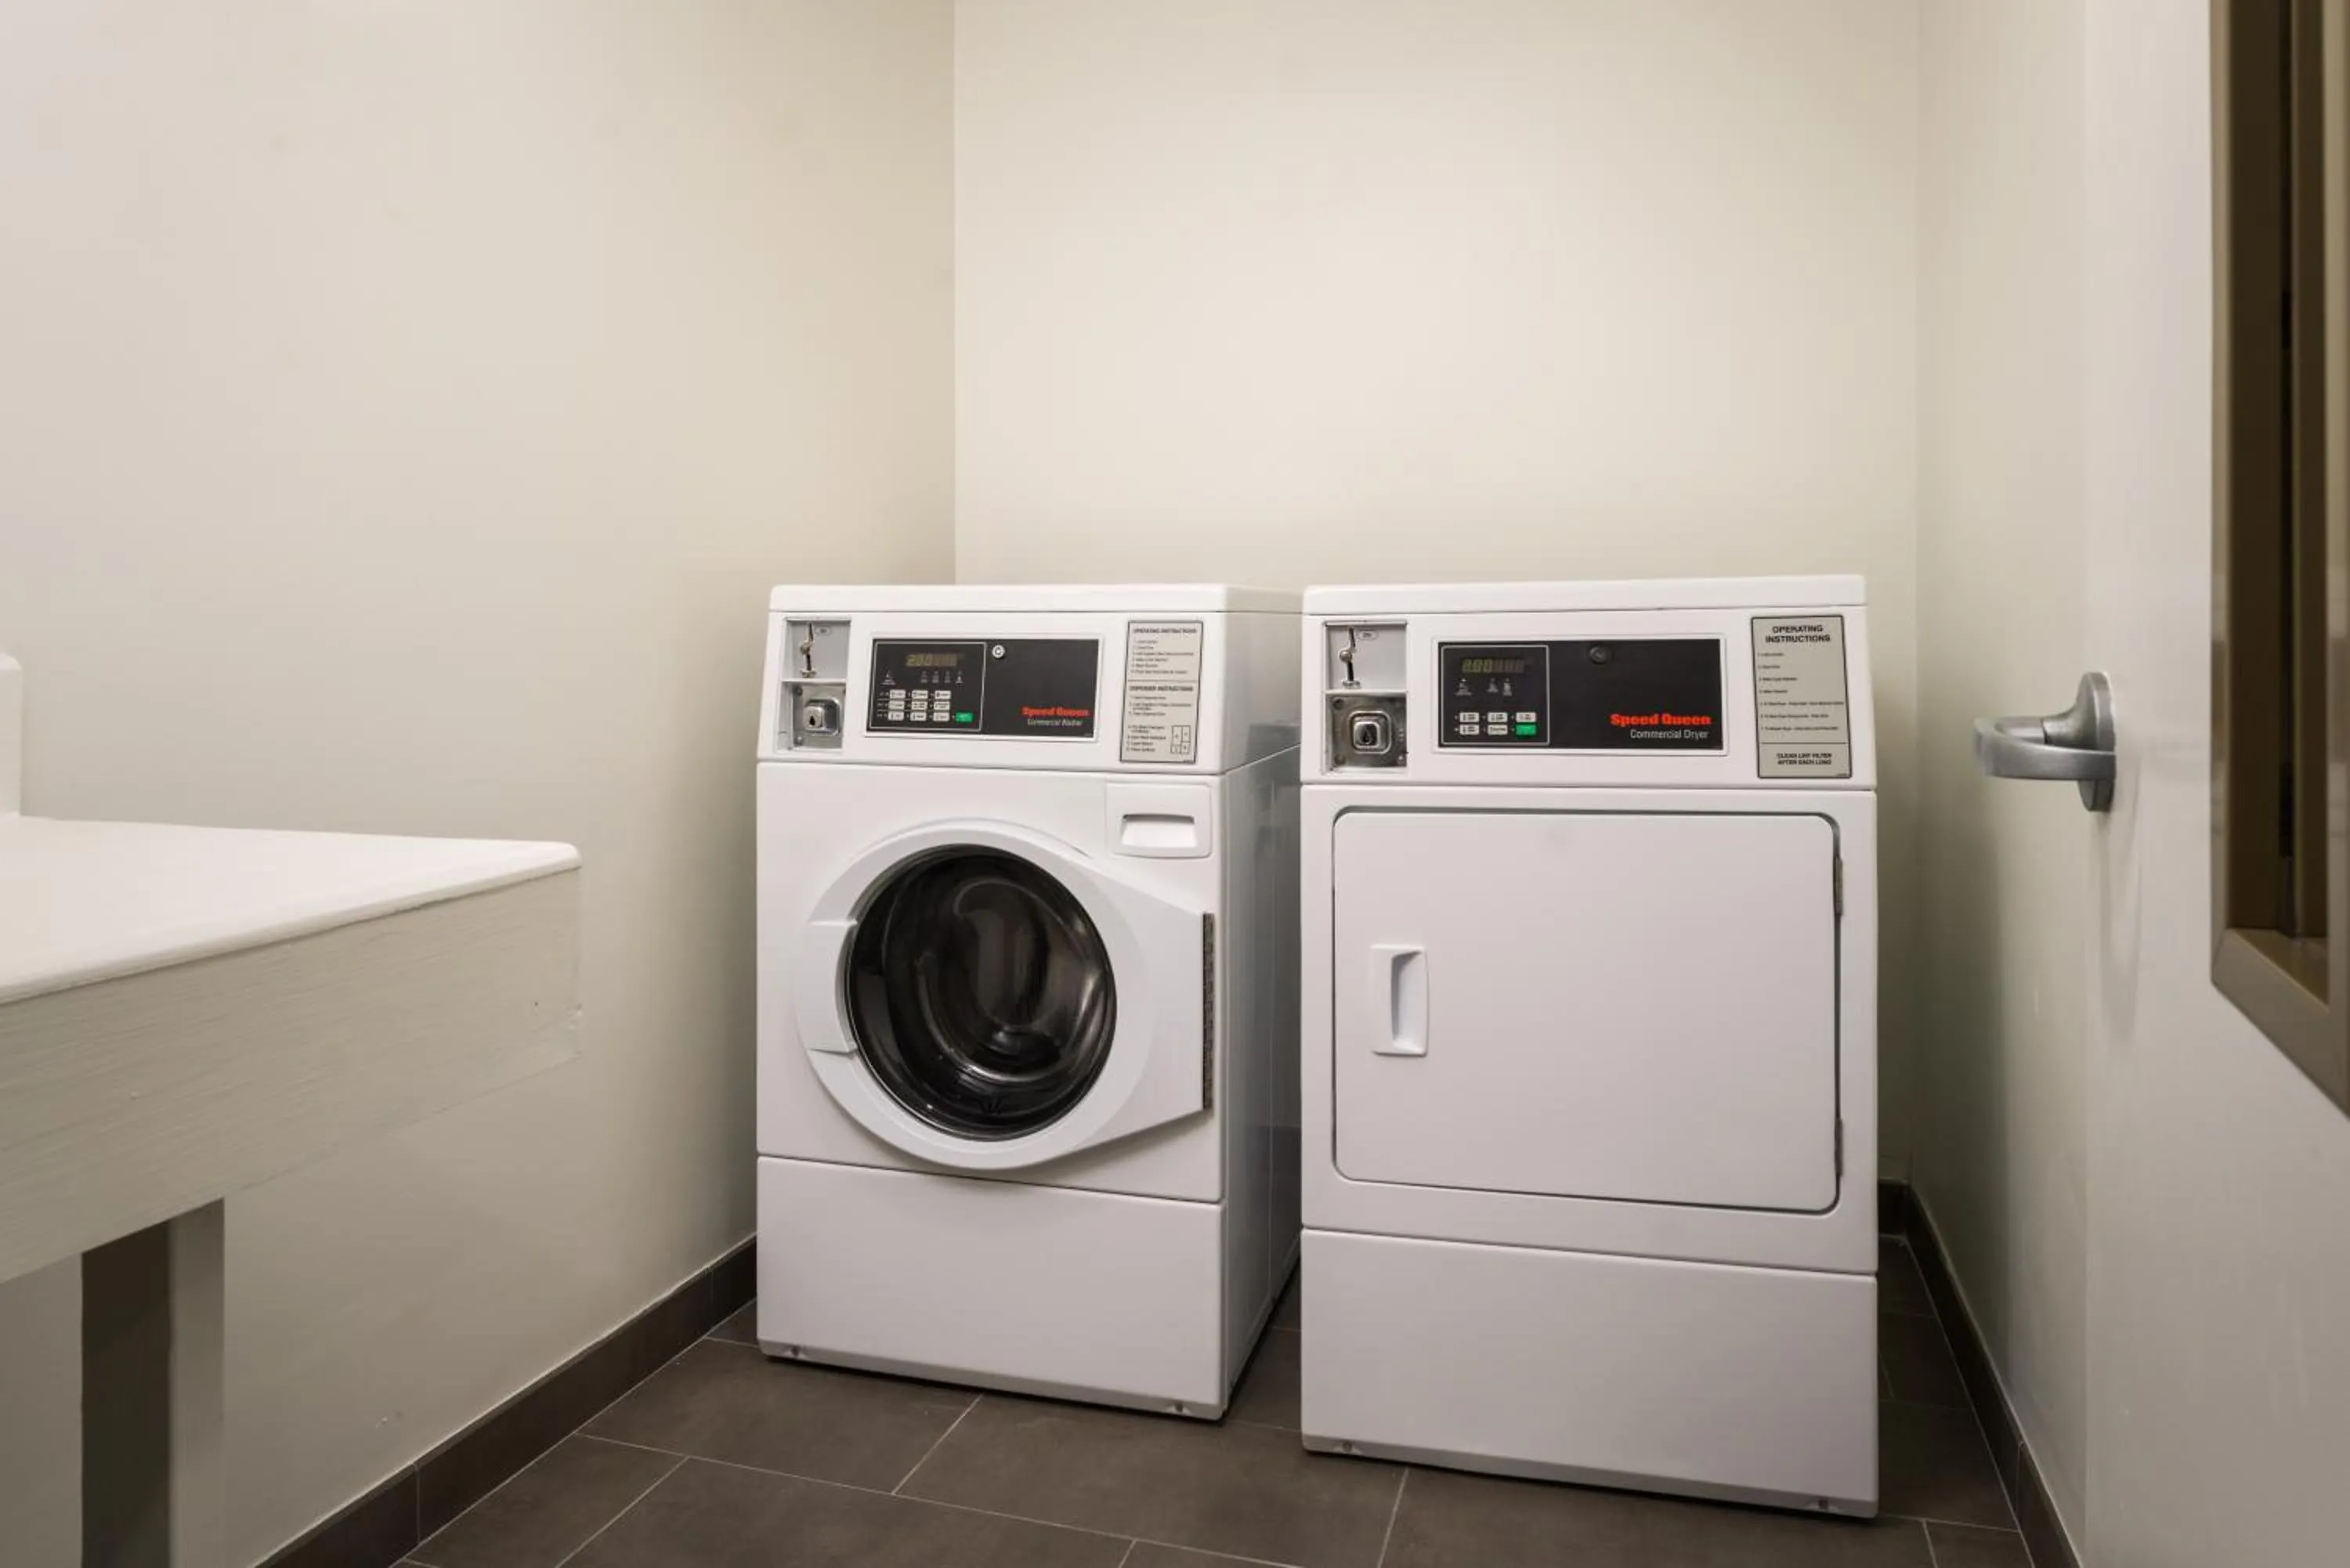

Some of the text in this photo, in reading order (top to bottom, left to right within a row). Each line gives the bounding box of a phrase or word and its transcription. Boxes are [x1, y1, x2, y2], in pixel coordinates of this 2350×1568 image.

[1771, 625, 1824, 634] OPERATING
[1765, 634, 1831, 643] INSTRUCTIONS
[1021, 706, 1090, 717] Speed Queen
[1610, 714, 1712, 727] Speed Queen
[1630, 729, 1708, 741] Commercial Dryer
